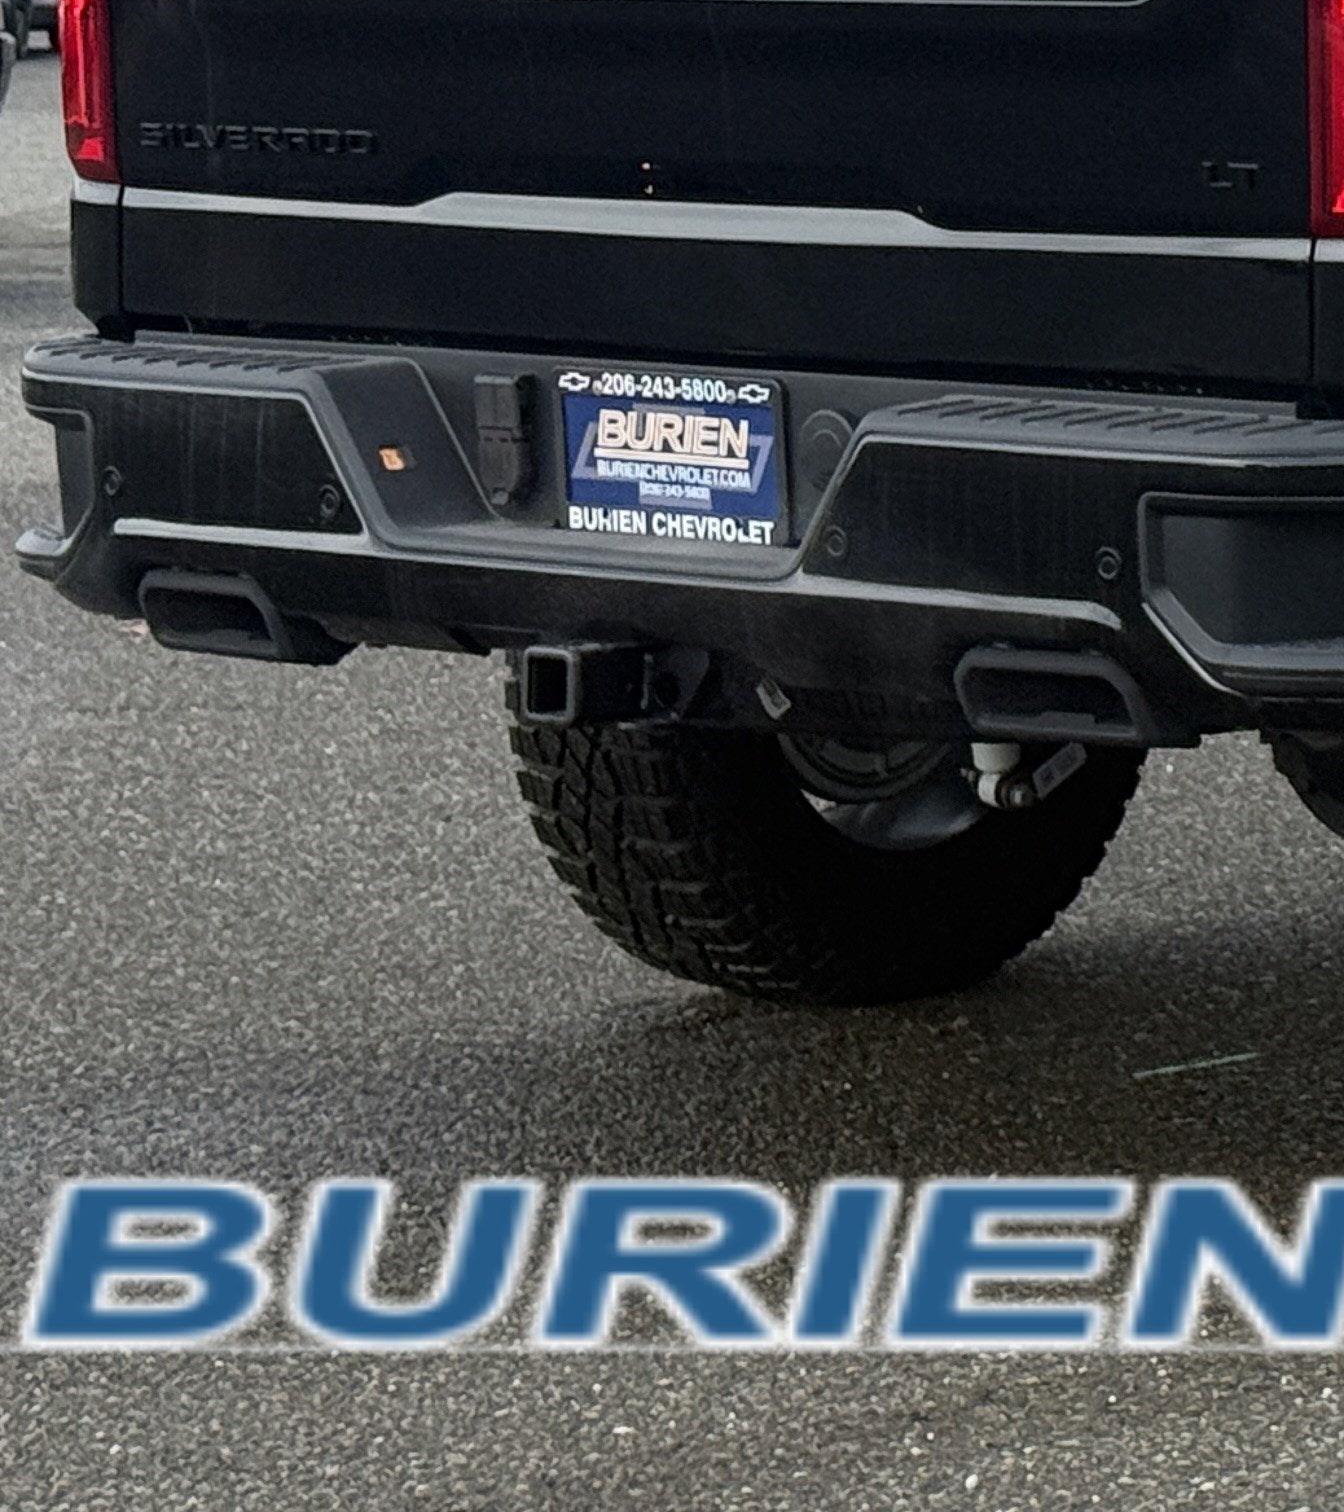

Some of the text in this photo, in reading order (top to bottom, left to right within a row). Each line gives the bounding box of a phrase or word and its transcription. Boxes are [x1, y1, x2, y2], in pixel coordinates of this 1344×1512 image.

[137, 122, 379, 156] SILVERADO
[1201, 161, 1259, 189] LT
[601, 372, 727, 403] 206-243-5800
[597, 408, 749, 458] BURIEN
